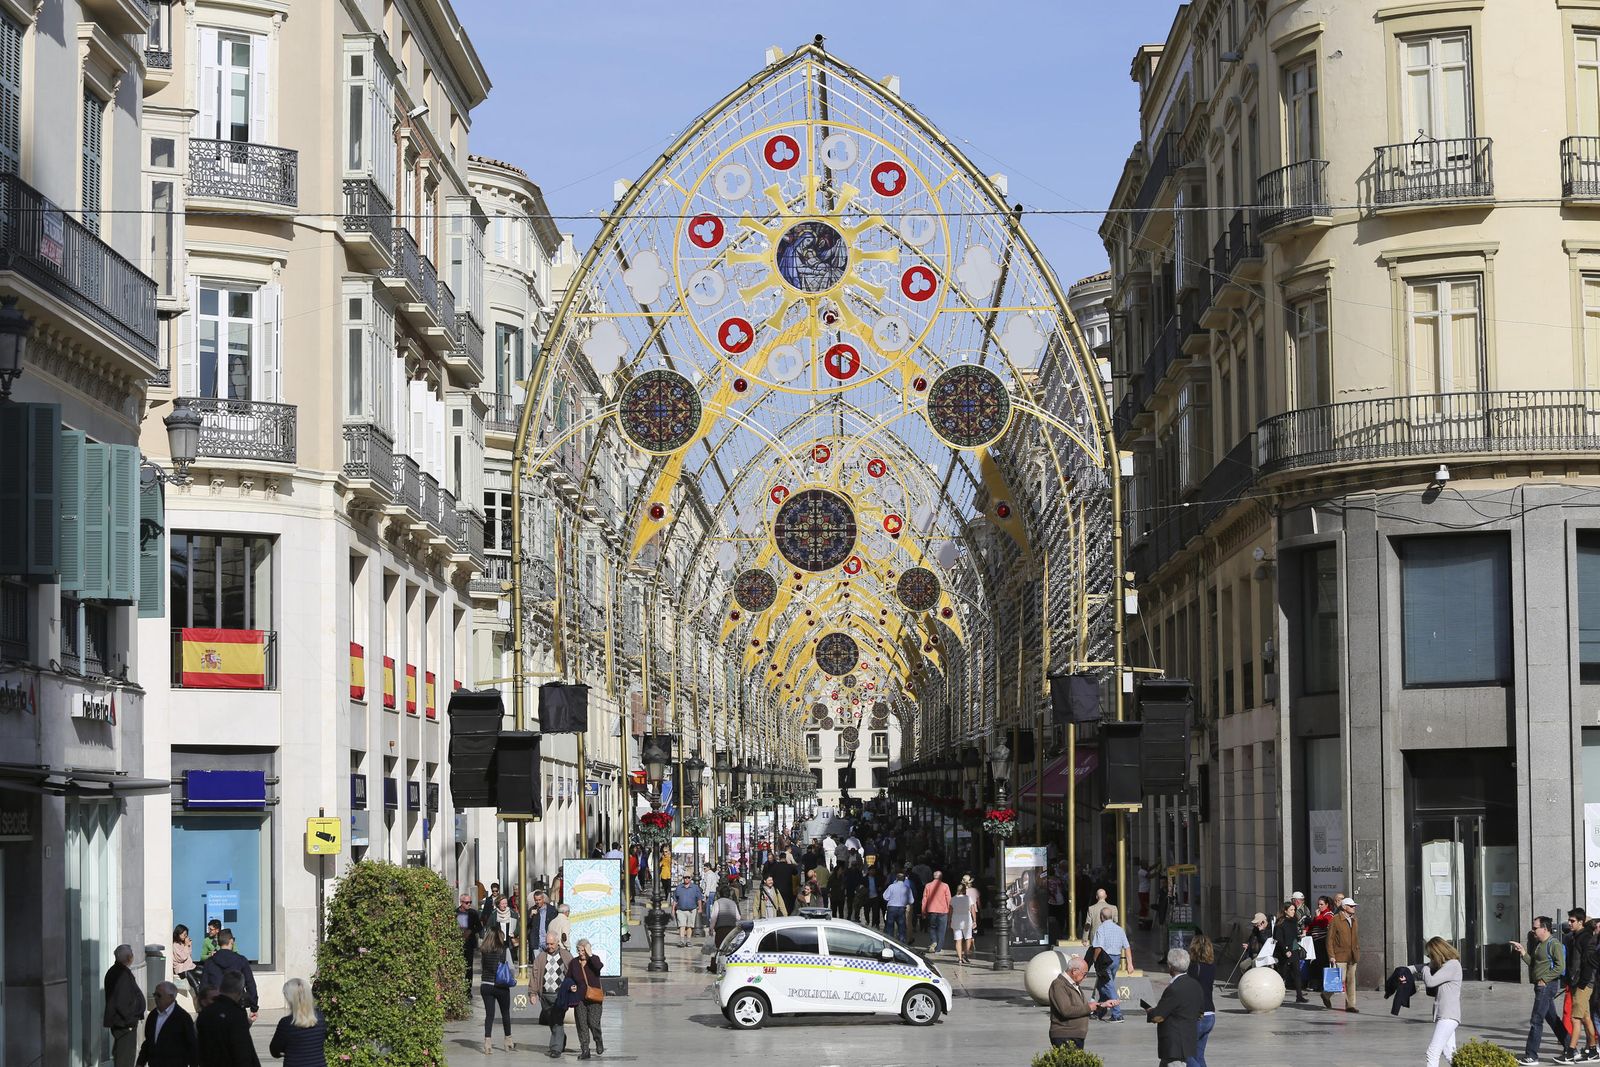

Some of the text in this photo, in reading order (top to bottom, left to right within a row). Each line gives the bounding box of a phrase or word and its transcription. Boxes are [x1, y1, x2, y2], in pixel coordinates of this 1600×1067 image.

[83, 693, 109, 720] helvetia
[788, 987, 887, 1003] POLICIA LOCAL
